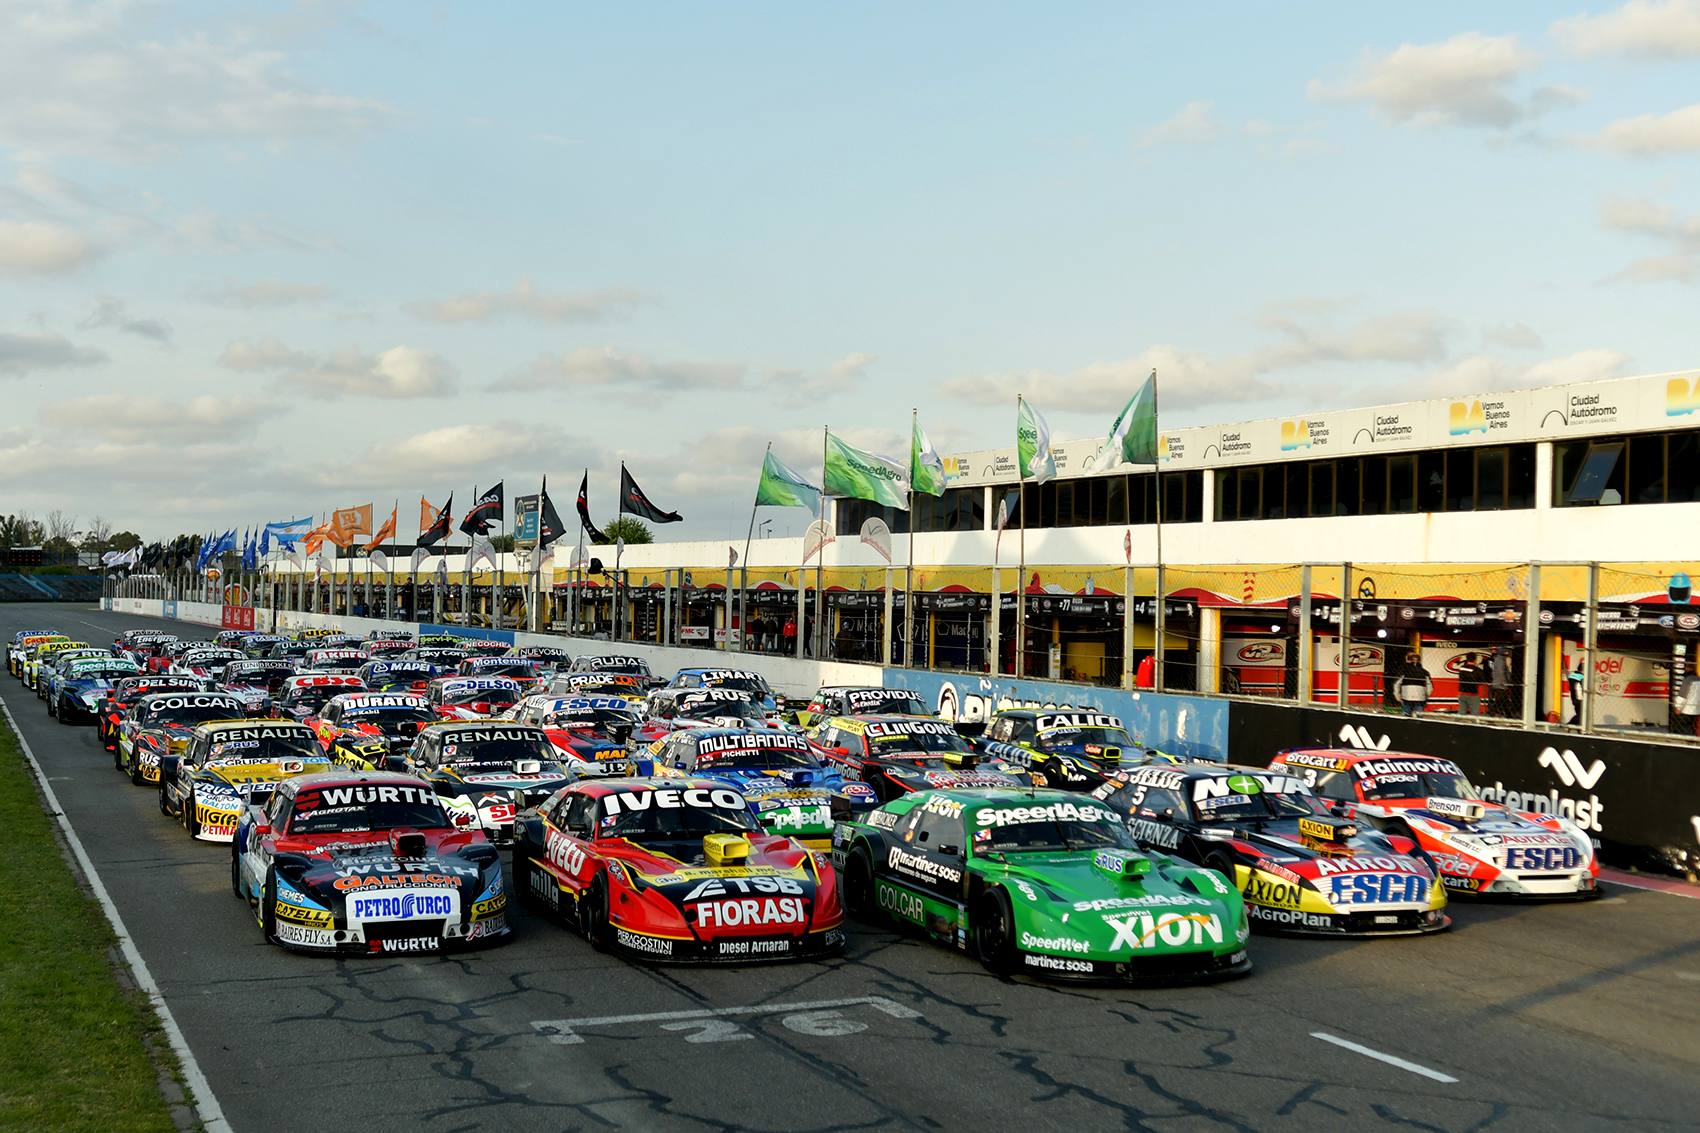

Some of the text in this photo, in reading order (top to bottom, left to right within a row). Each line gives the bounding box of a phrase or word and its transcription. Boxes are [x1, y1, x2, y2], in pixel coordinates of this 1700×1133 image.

[1482, 402, 1504, 410] Vamos
[1571, 394, 1600, 406] Ciudad
[1486, 410, 1510, 420] Buenos
[1570, 406, 1617, 418] Autódromo
[1307, 420, 1325, 428] Vamos
[1376, 415, 1399, 426] Ciudad
[1490, 420, 1508, 429] Aires
[1222, 433, 1240, 442] Ciudad
[1310, 428, 1329, 437] Buenos
[1376, 425, 1412, 436] Autódromo
[1312, 437, 1327, 445] Aires
[847, 459, 902, 482] SpeedAgro
[318, 650, 367, 659] Akuro
[73, 662, 137, 672] SpeedAgro
[390, 662, 430, 672] MAPEI
[344, 696, 429, 710] DURATOP
[712, 691, 751, 702] RUS
[849, 690, 925, 703] PROVIDUS
[150, 698, 238, 712] COLCAR
[553, 698, 627, 711] ESCO
[1037, 714, 1123, 732] CALICO
[213, 729, 314, 743] RENAULT
[445, 729, 546, 744] RENAULT
[699, 734, 807, 752] MULTIBANDAS
[140, 752, 160, 766] RUS
[721, 750, 759, 758] PICHETTI
[985, 742, 1032, 768] CALICO
[1286, 753, 1337, 768] Brocart
[467, 774, 565, 782] PALADINI
[1303, 769, 1317, 788] 3
[201, 784, 234, 794] RUS
[1132, 786, 1148, 806] 5
[202, 799, 238, 810] BALTON
[604, 789, 745, 816] IVECO
[922, 795, 967, 819] XION
[1206, 796, 1244, 808] ESCO
[1429, 800, 1461, 813] Brenson
[976, 803, 1122, 828] SpeedAgro
[1301, 822, 1332, 837] AXION
[547, 831, 587, 876] IVECO
[1505, 847, 1579, 870] ESCO
[1102, 858, 1122, 873] RUS
[1318, 856, 1418, 876] AKRON
[939, 865, 961, 882] sosa
[1243, 877, 1302, 904] AXION
[1330, 874, 1427, 903] ESCO
[355, 895, 400, 918] PETRO
[880, 885, 924, 922] COLCAR
[1073, 895, 1212, 912] SpeedAgro
[697, 899, 804, 928] FIORASI
[1252, 906, 1331, 927] AgroPlan
[305, 928, 320, 944] FLY
[1105, 913, 1222, 952] XION
[618, 929, 672, 951] PIERAGOSTINI
[1021, 932, 1090, 954] SpeedWet
[720, 942, 749, 954] Diesel
[1066, 958, 1093, 972] sosa
